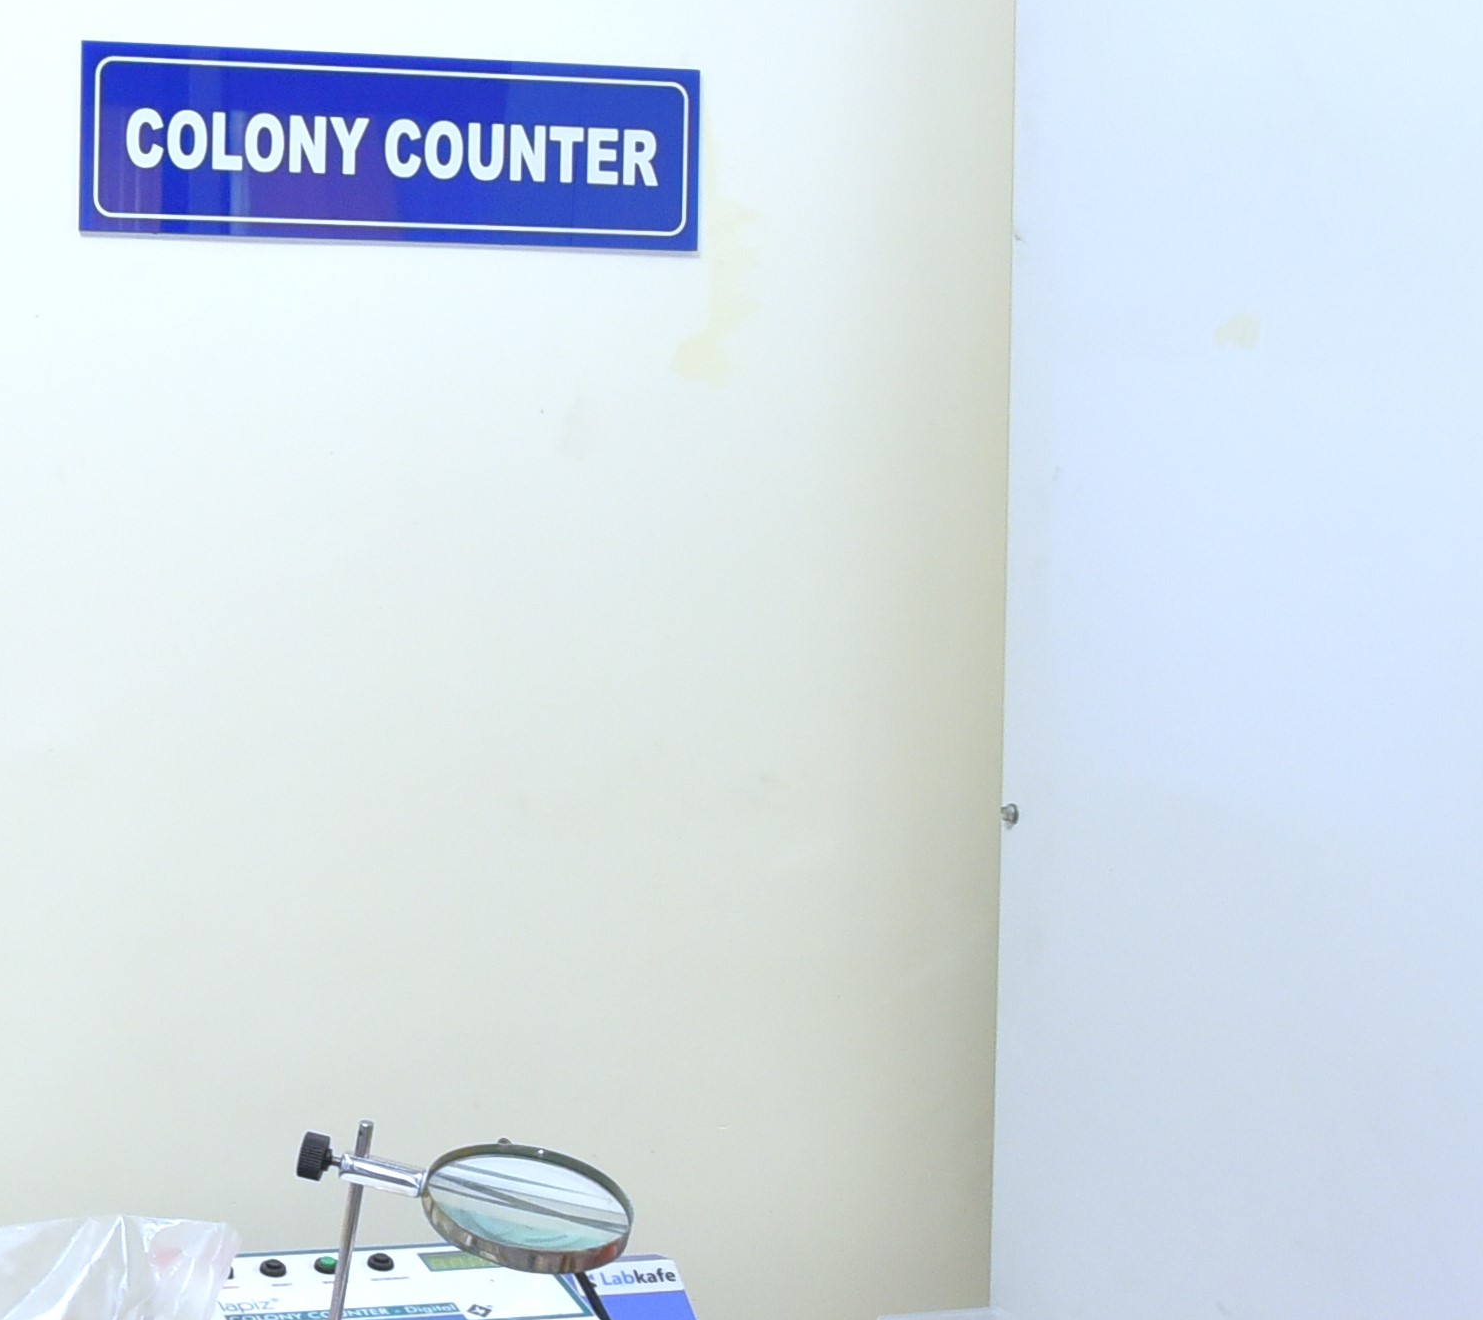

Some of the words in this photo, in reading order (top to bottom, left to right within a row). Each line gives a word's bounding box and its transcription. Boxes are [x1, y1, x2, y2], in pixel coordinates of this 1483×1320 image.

[126, 108, 369, 175] COLONY
[385, 120, 658, 187] COUNTER
[601, 1267, 677, 1287] Labkafe
[404, 1303, 457, 1315] Digital
